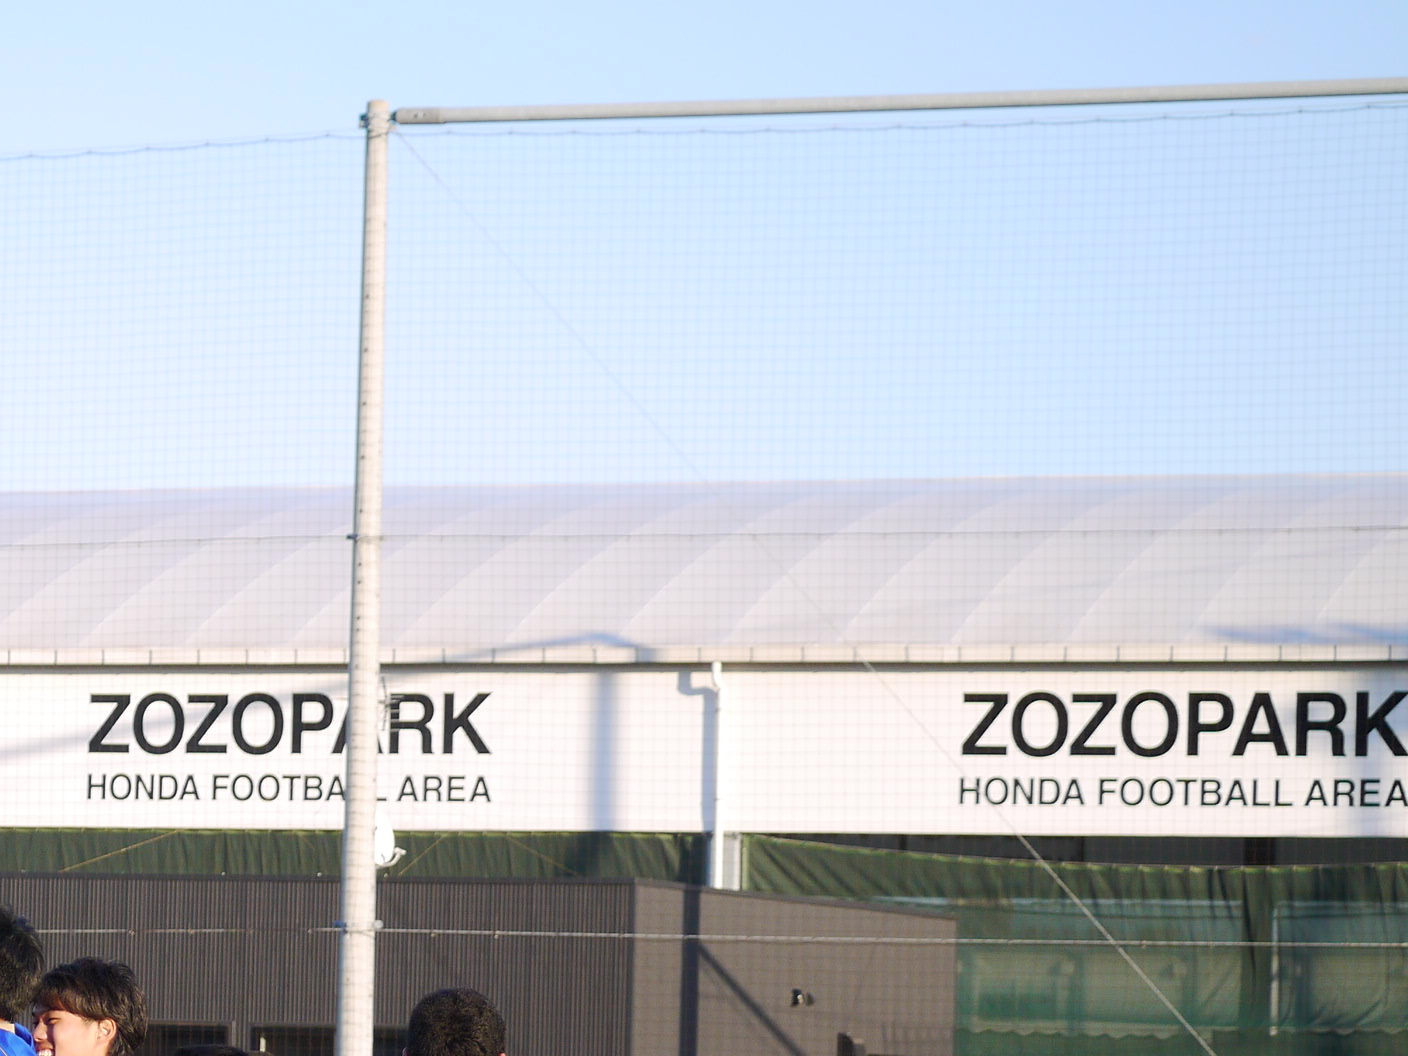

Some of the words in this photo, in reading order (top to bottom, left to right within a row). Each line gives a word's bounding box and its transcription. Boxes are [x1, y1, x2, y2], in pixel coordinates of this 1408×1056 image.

[961, 689, 1408, 758] ZOZOPARK
[87, 773, 200, 801] HONDA
[212, 774, 387, 803] FOOTBA
[396, 775, 492, 803] AREA
[959, 777, 1085, 806] HONDA
[1098, 777, 1293, 807] FOOTBALL
[1304, 777, 1408, 808] AREA
